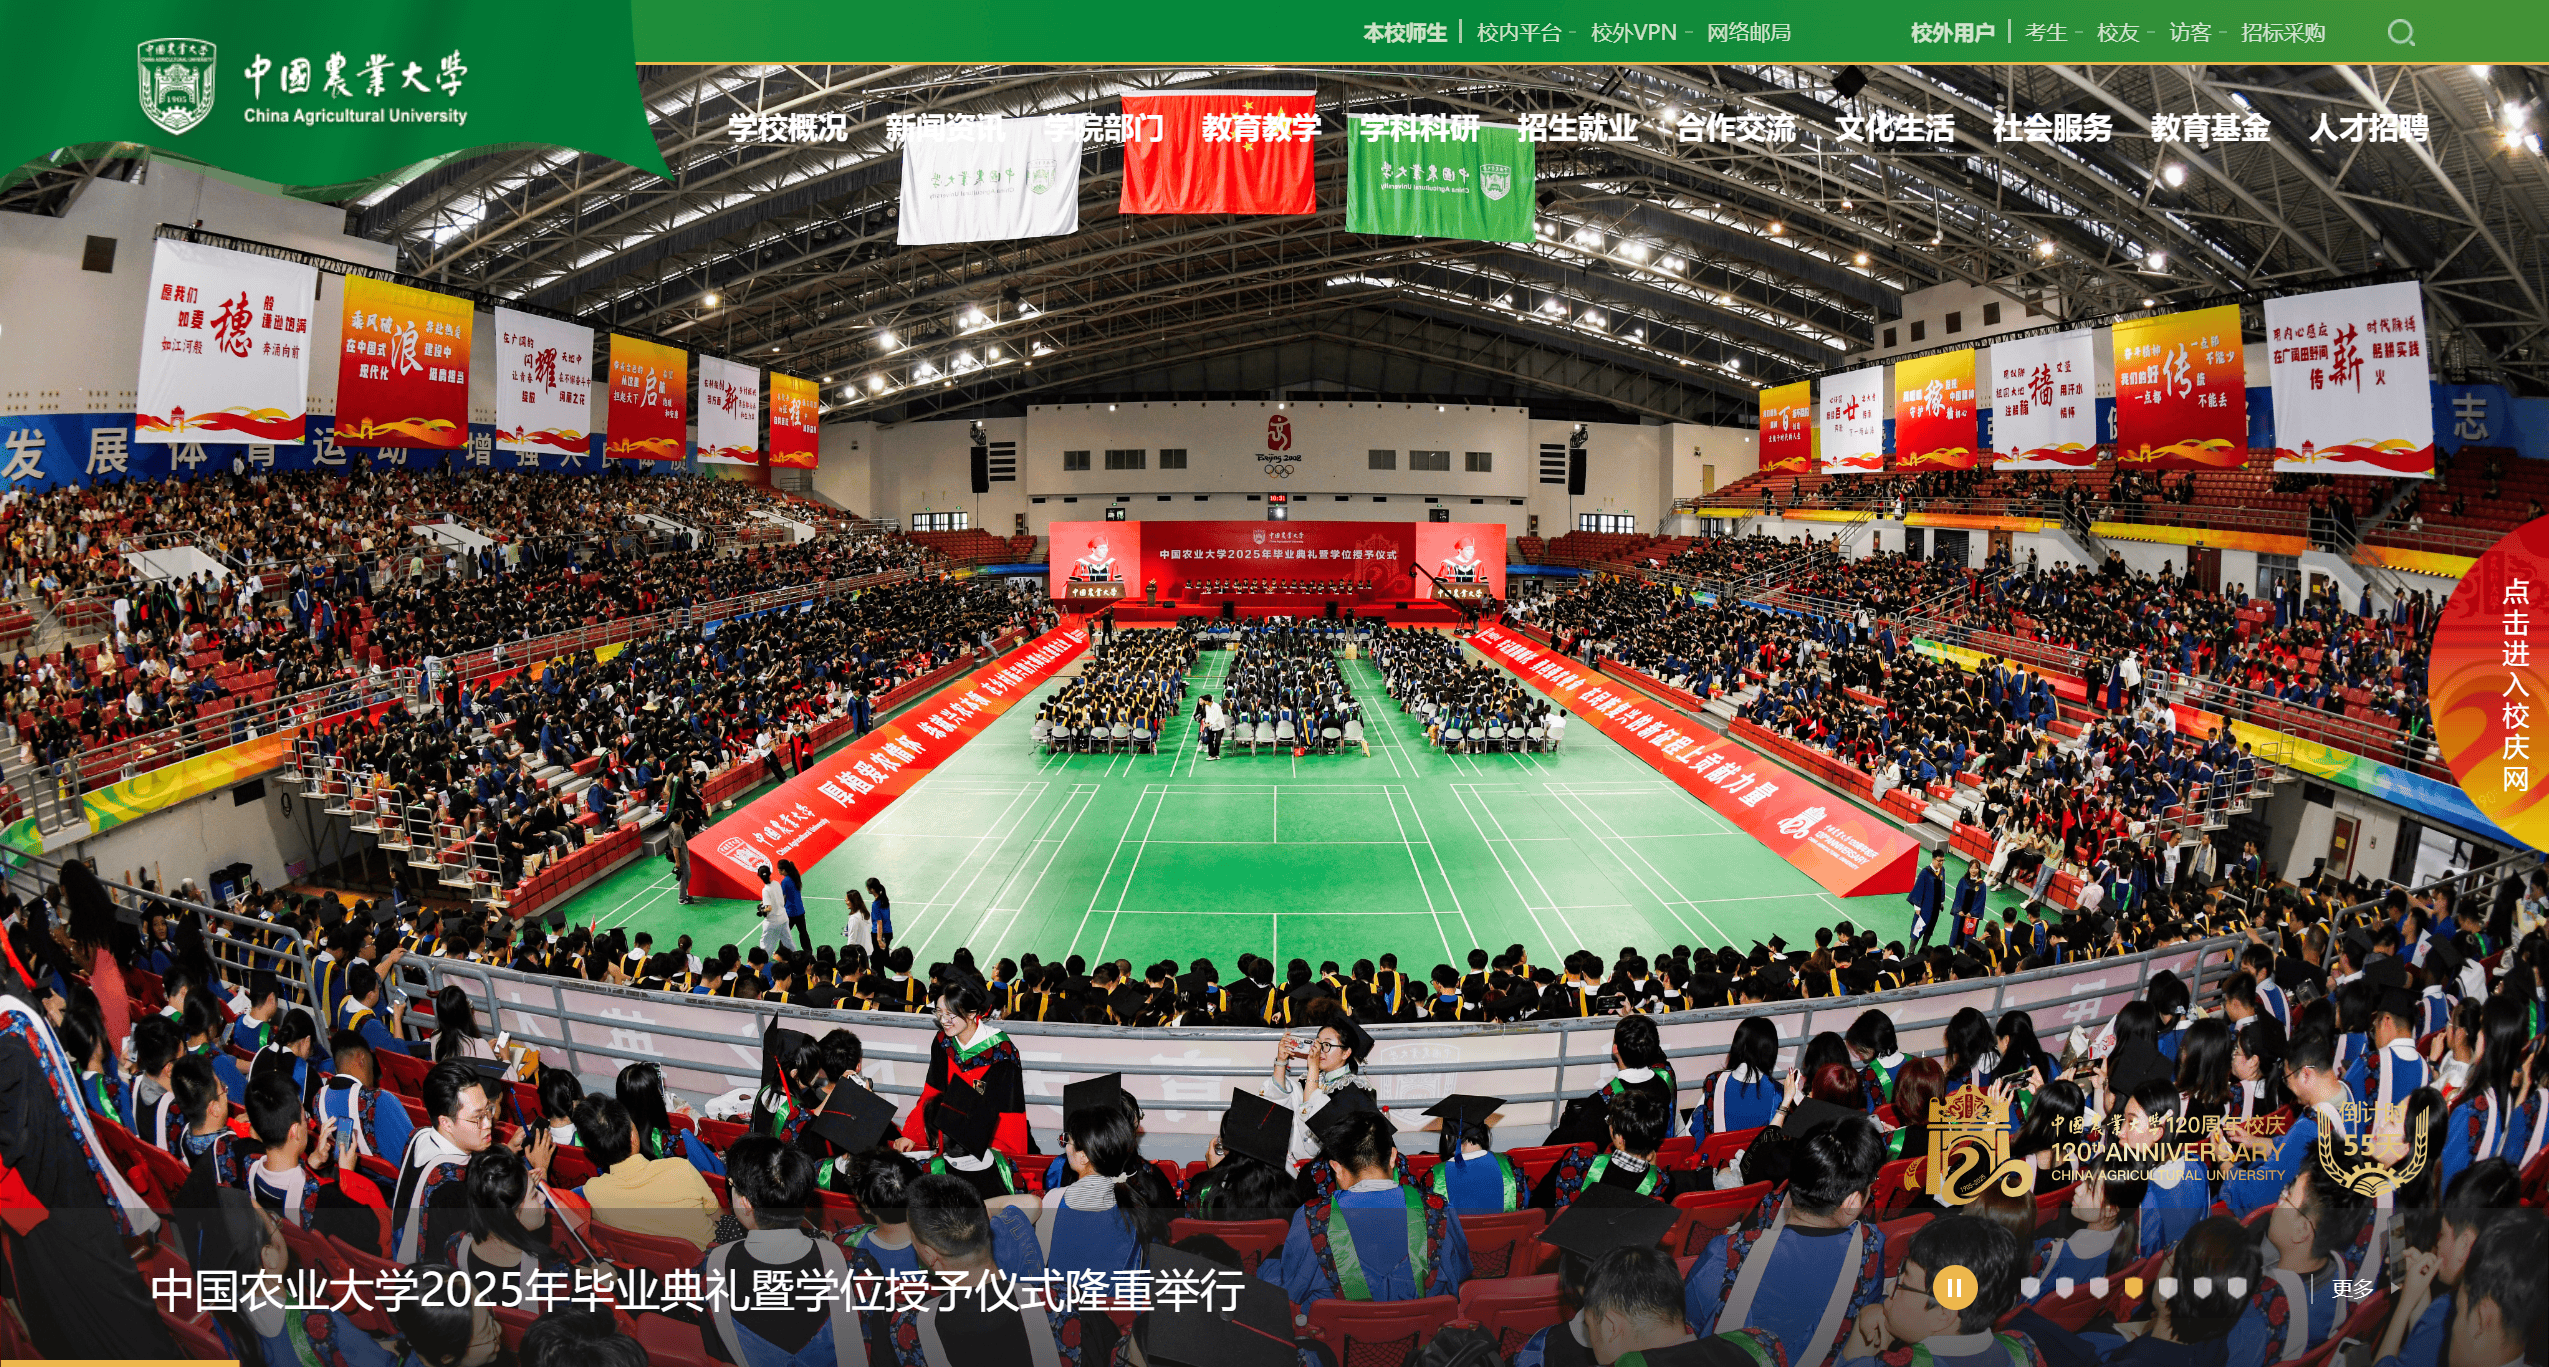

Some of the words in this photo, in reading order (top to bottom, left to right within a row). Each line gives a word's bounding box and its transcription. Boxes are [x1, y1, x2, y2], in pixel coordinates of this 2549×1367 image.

[161, 284, 198, 304] 愿我们
[264, 296, 274, 312] 般
[178, 310, 204, 329] 如麦
[210, 291, 253, 358] 穗
[262, 313, 307, 334] 谦逊饱满
[351, 310, 393, 334] 乘风破
[2366, 315, 2416, 334] 时代脉搏
[426, 320, 461, 340] 奔赴热爱
[2273, 322, 2328, 342] 用内心感应
[161, 336, 203, 355] 如江河般
[346, 338, 386, 357] 在中国式
[391, 320, 424, 376] 浪
[504, 332, 534, 348] 在广阔的
[2191, 335, 2220, 350] 一点都
[2372, 340, 2420, 359] 躬耕实践
[262, 341, 300, 359] 奔涌向前
[424, 342, 452, 359] 建设中
[562, 352, 582, 365] 天地中
[2206, 350, 2235, 365] 不能少
[2274, 344, 2328, 364] 在广阔田野间
[2328, 323, 2364, 394] 薪
[524, 354, 533, 369] 闪
[2056, 360, 2072, 373] 丈量
[2163, 342, 2192, 399] 传
[359, 364, 389, 380] 现代化
[512, 370, 534, 384] 让青春
[2121, 364, 2159, 386] 我们的好
[2196, 372, 2206, 386] 统
[2310, 368, 2324, 390] 传
[2376, 369, 2386, 386] 火
[640, 366, 658, 408] 启
[1996, 386, 2024, 398] 祖国大地
[2060, 383, 2084, 396] 用汗水
[614, 390, 638, 404] 担起天下
[2134, 390, 2162, 405] 一点都
[2198, 392, 2228, 408] 不能丢
[1255, 453, 1282, 464] Beijing
[1159, 549, 1397, 560] 中国农业大学2025年毕业典礼暨学位授予仪式
[916, 691, 992, 740] 练就兴农本领
[1578, 686, 1780, 808] 在民族复兴的新征程上贡献力量
[817, 735, 926, 809] 厚植爱农情怀
